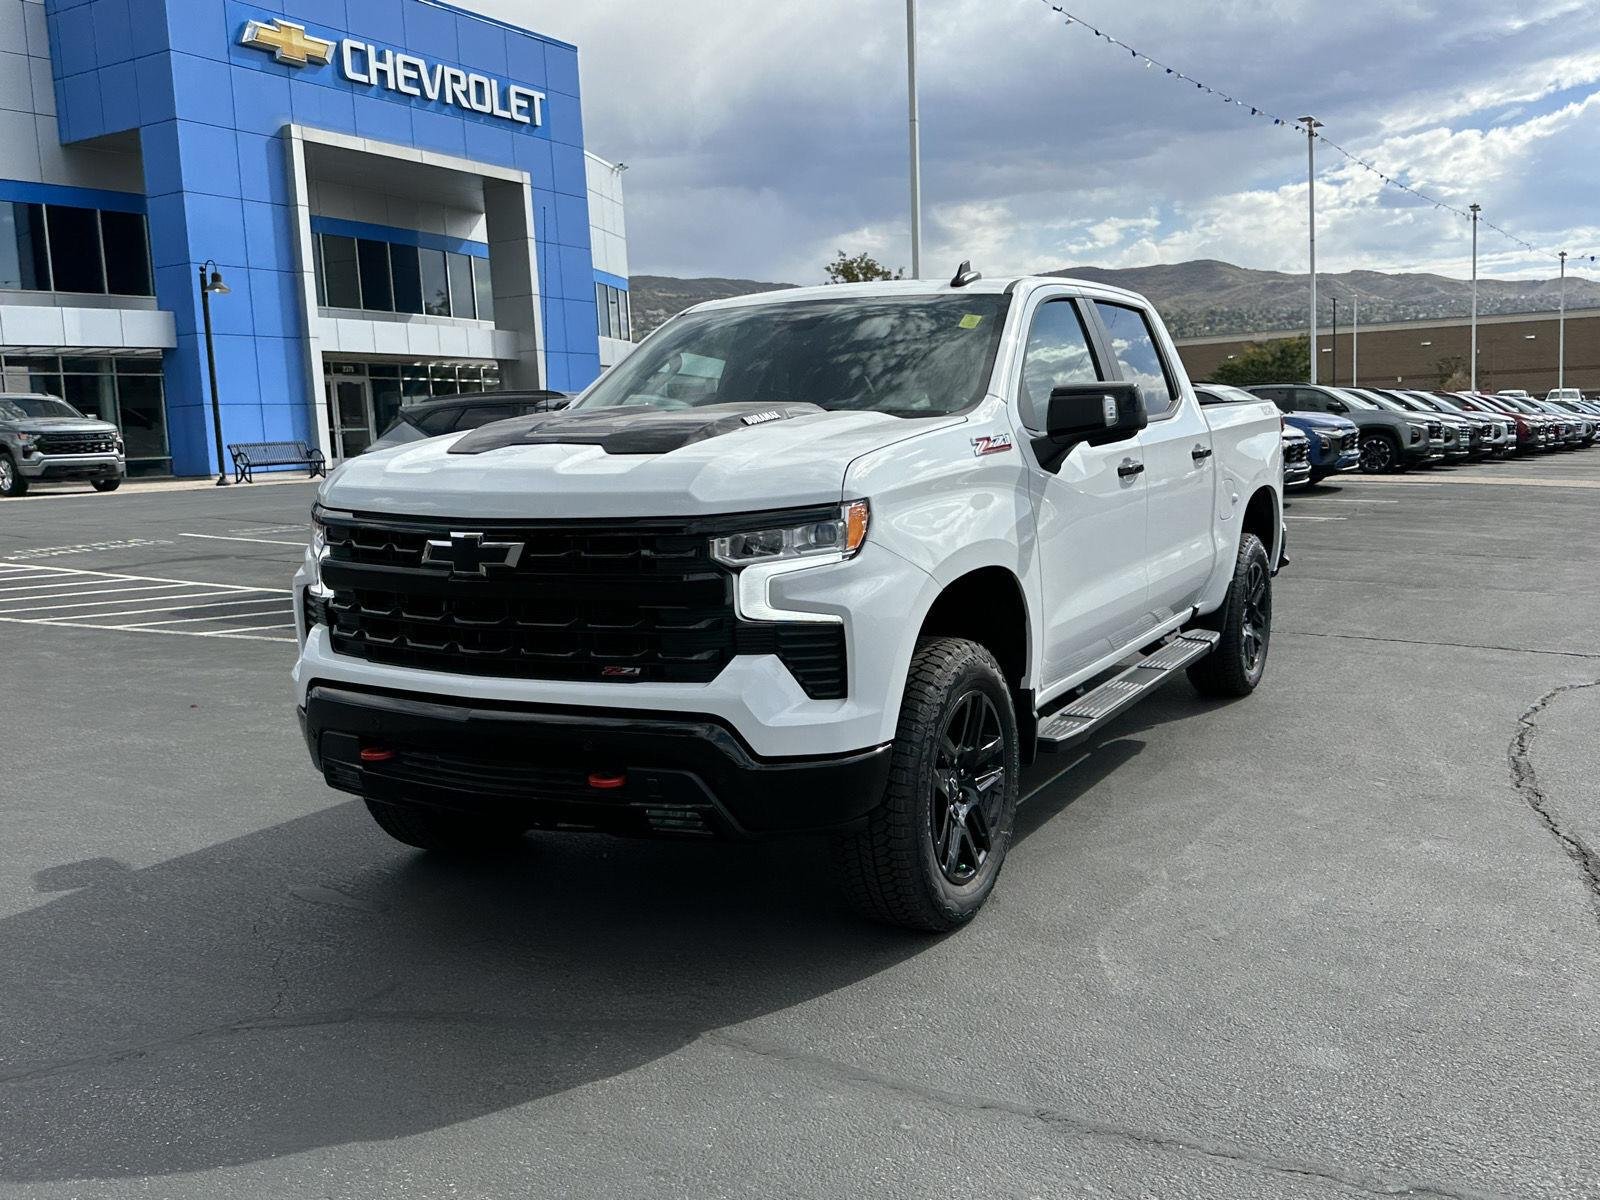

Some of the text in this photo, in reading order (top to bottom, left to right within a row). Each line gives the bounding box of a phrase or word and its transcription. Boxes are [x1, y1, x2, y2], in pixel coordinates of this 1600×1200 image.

[341, 38, 545, 127] CHEVROLET
[743, 411, 781, 425] DURAMAX
[970, 433, 1012, 457] Z71
[602, 666, 641, 676] Z71
